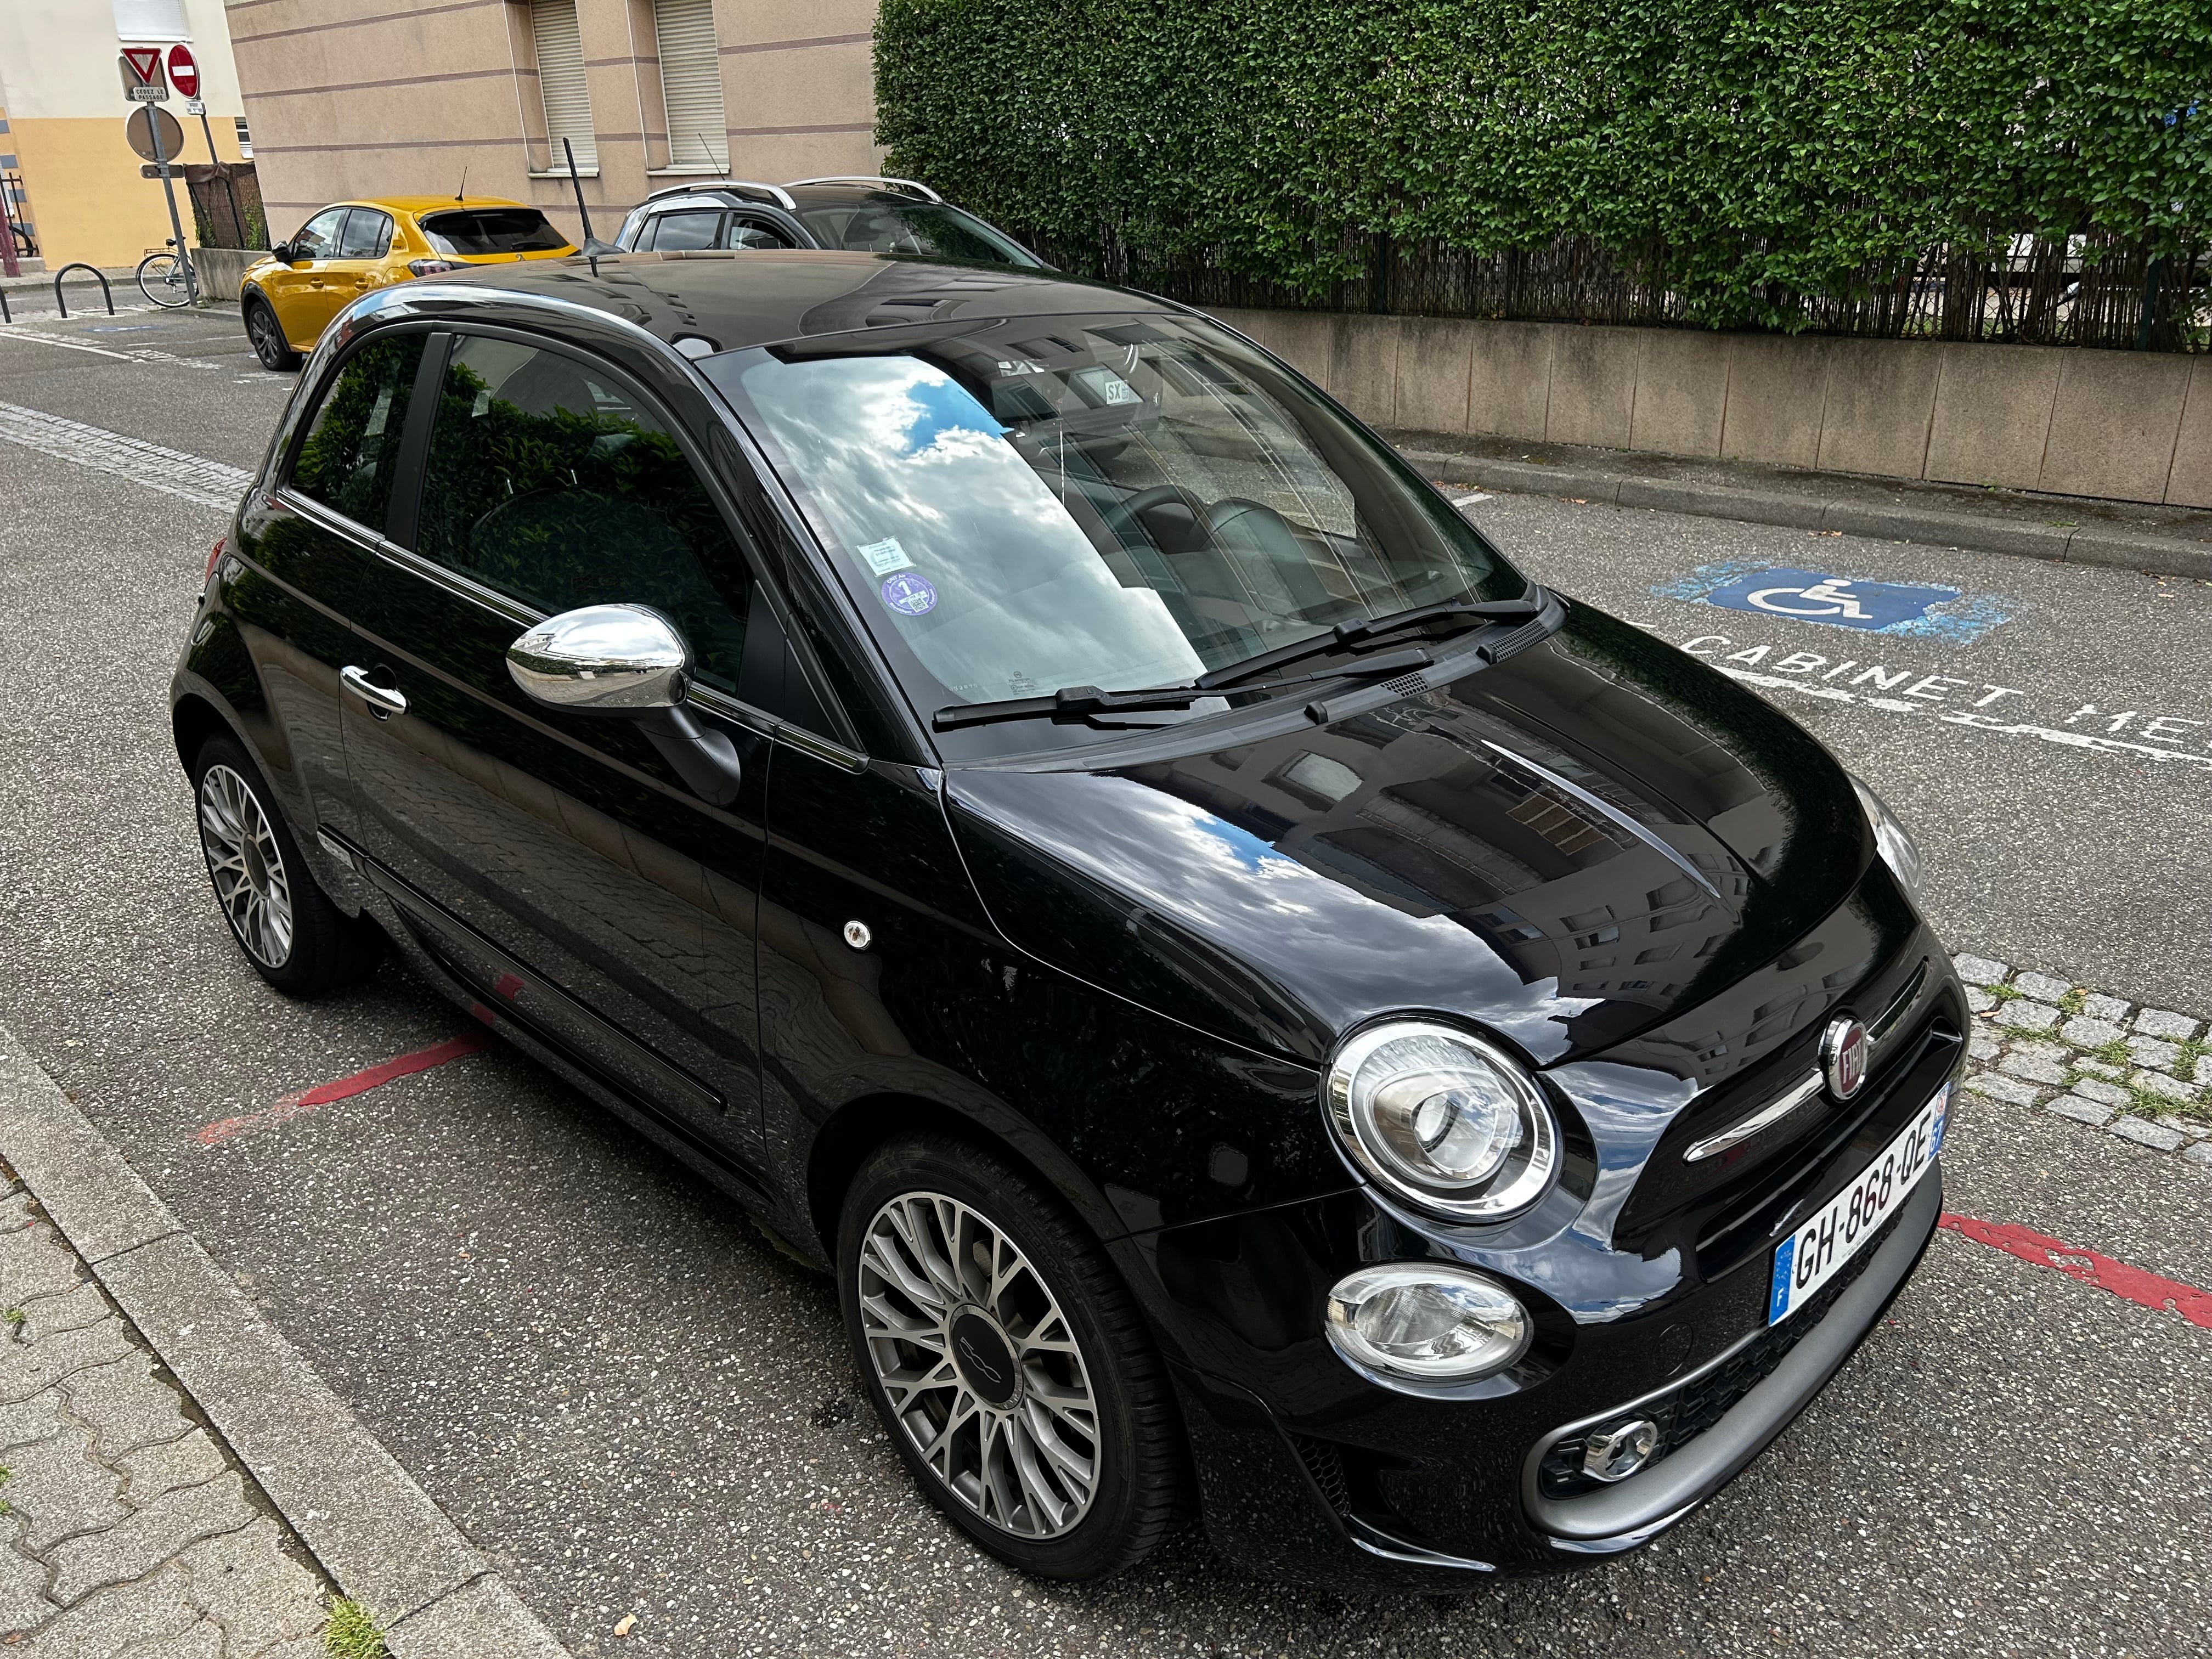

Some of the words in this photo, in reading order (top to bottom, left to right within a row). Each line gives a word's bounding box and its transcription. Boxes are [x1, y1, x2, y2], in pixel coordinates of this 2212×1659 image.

[898, 580, 912, 596] 1
[1679, 635, 2024, 708] CABINET
[2064, 704, 2212, 749] ME
[1842, 1037, 1862, 1085] FIAT
[1930, 1119, 1943, 1153] 67
[1796, 1110, 1931, 1290] GH-868-QE
[1776, 1287, 1785, 1307] F
